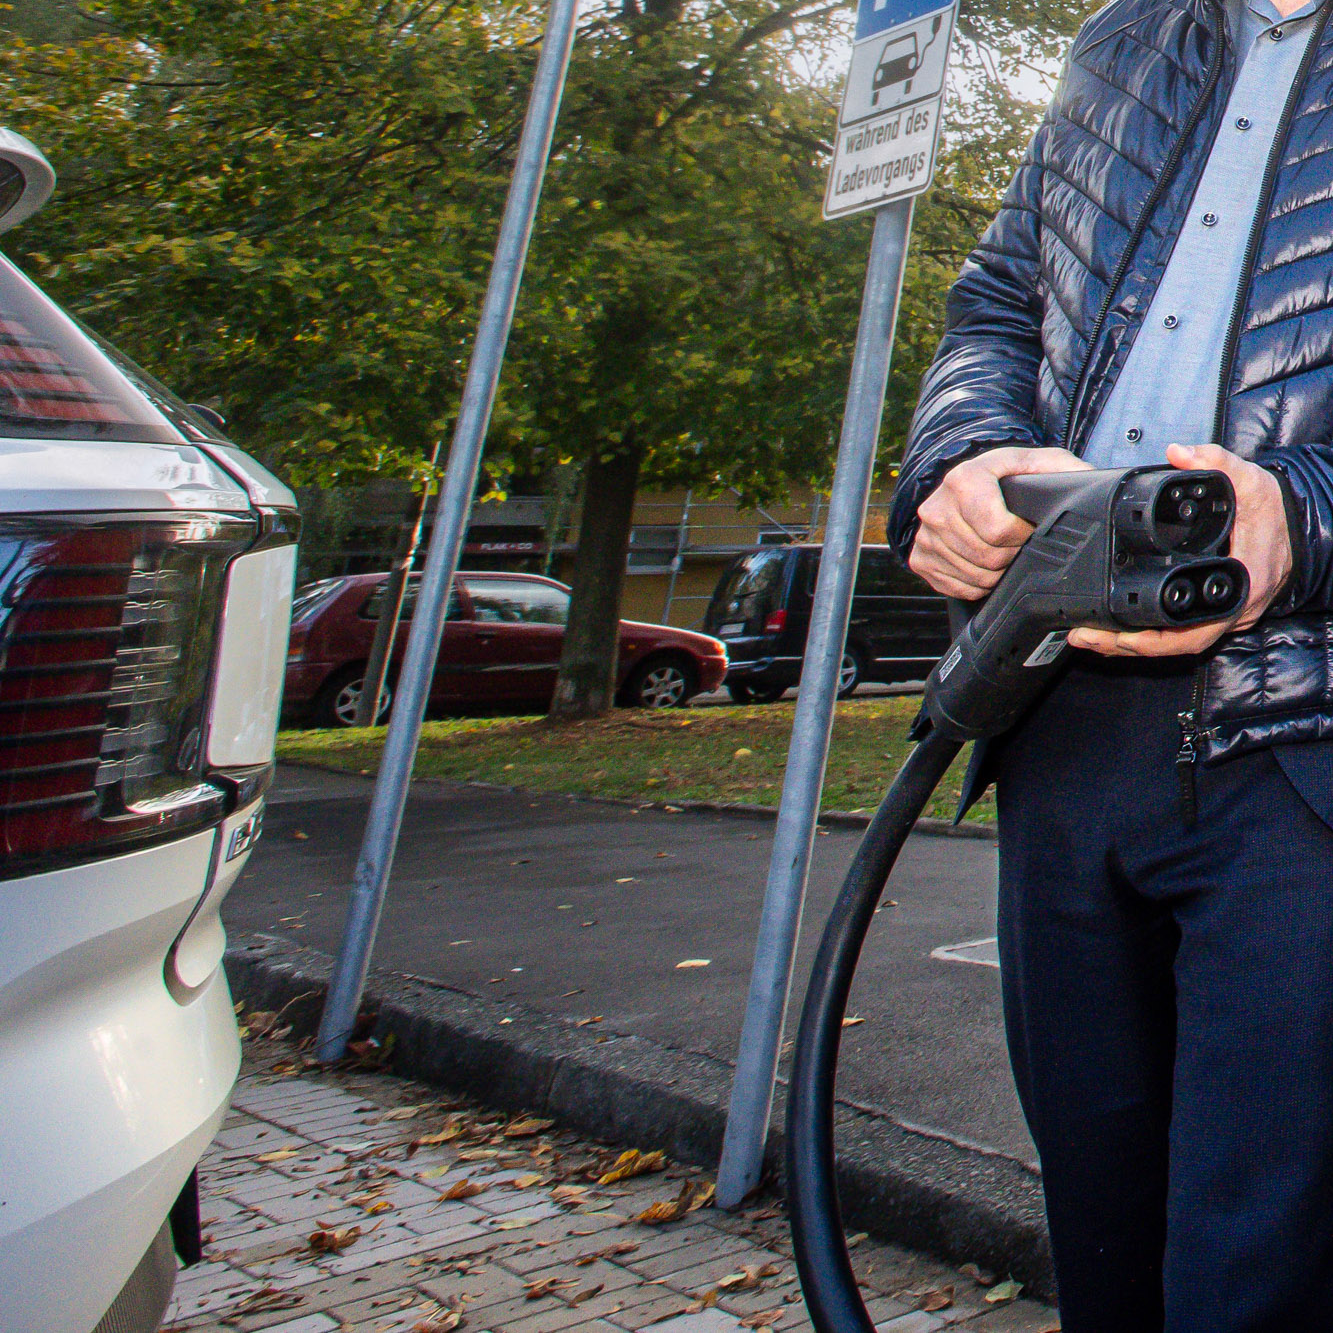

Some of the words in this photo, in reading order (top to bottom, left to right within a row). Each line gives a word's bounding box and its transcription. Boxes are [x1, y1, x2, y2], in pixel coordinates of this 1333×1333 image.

[845, 112, 901, 155] während
[905, 107, 929, 136] des
[835, 151, 926, 197] Ladevorgangs
